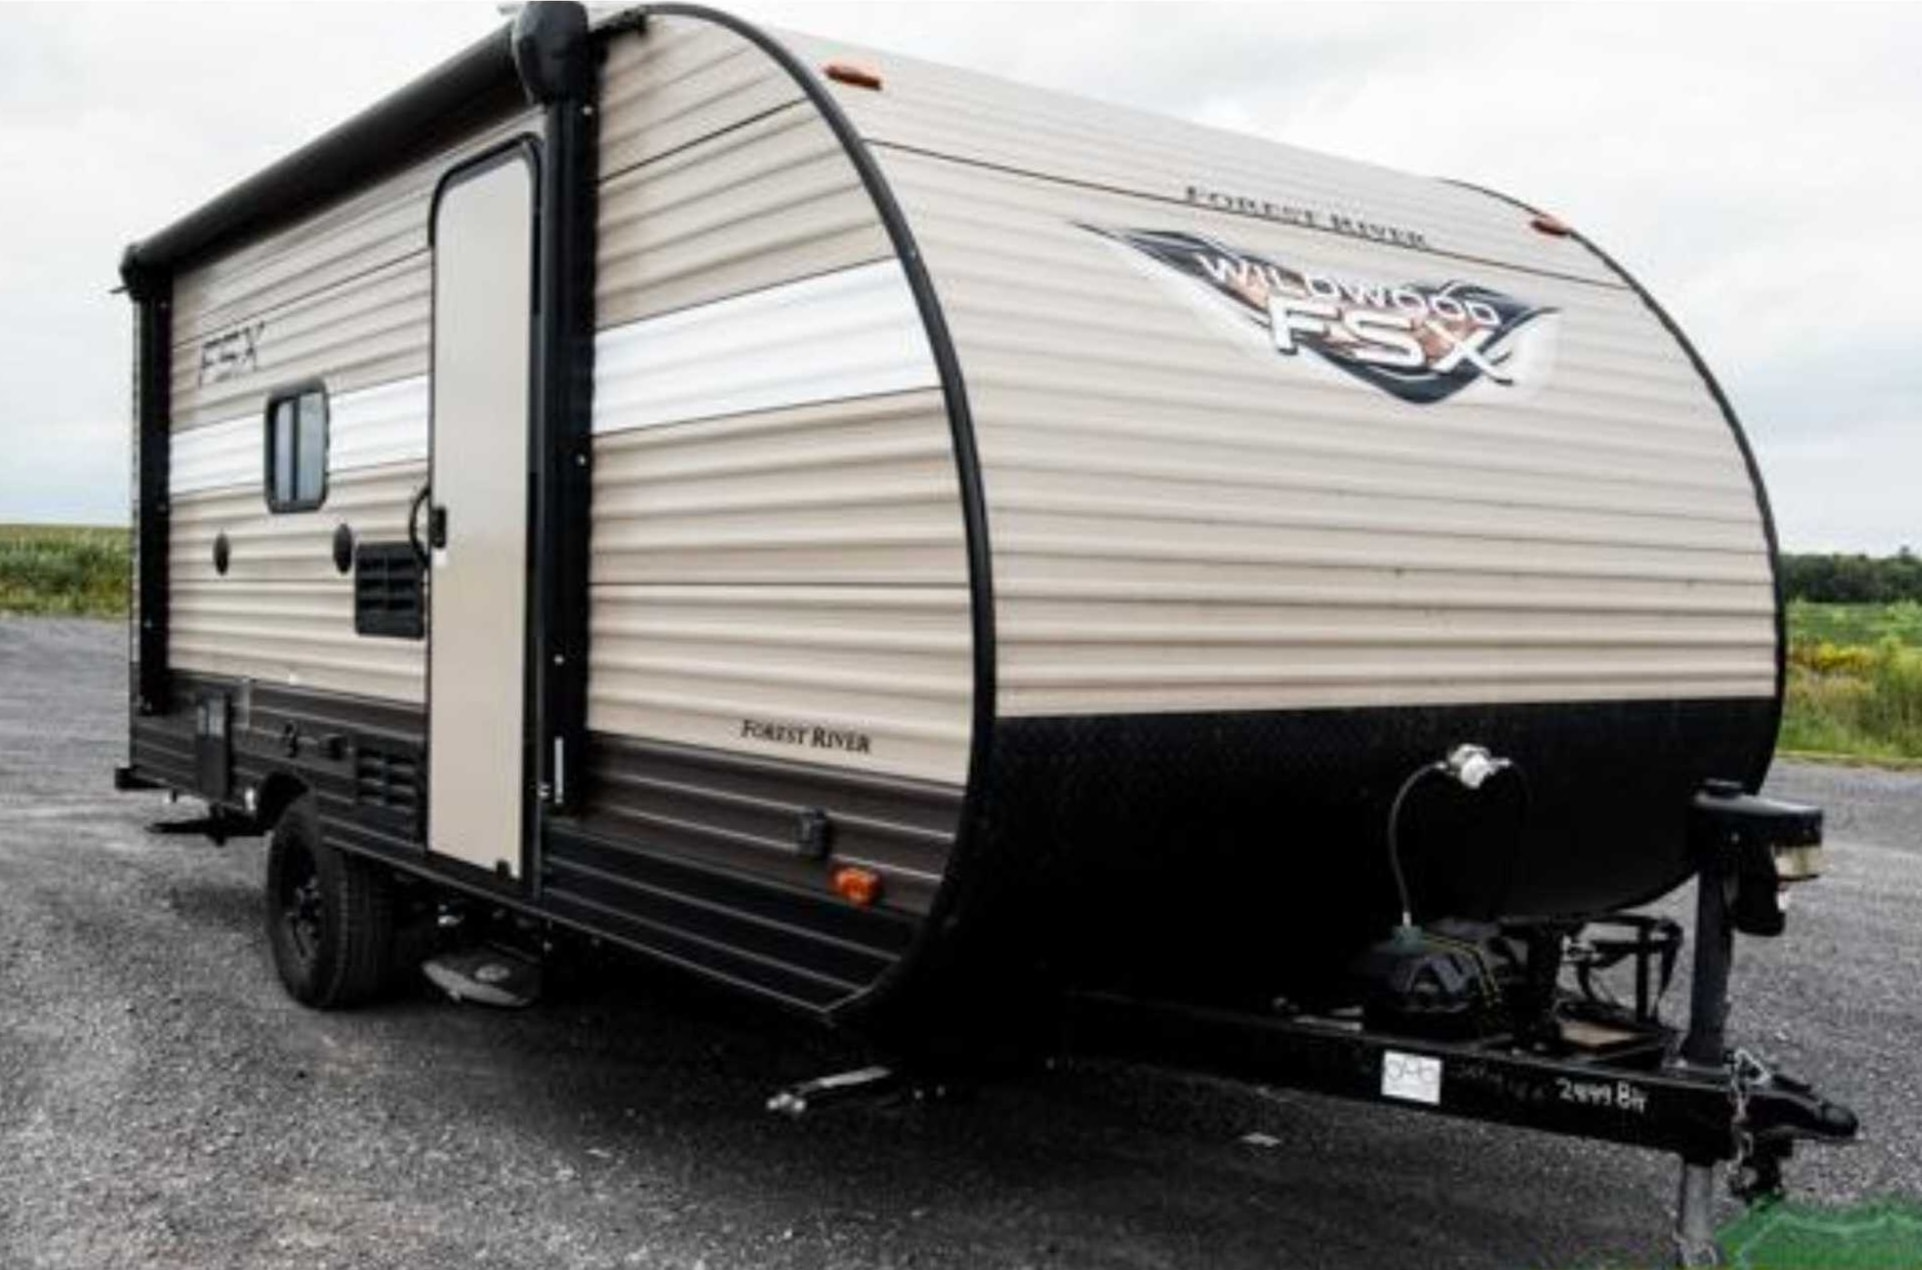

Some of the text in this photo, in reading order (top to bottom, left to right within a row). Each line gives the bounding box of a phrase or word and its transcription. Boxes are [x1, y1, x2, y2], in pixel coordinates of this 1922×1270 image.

[1199, 252, 1501, 327] WILDWOOD
[1266, 296, 1516, 387] FSX
[741, 719, 871, 754] FOREST RIVER
